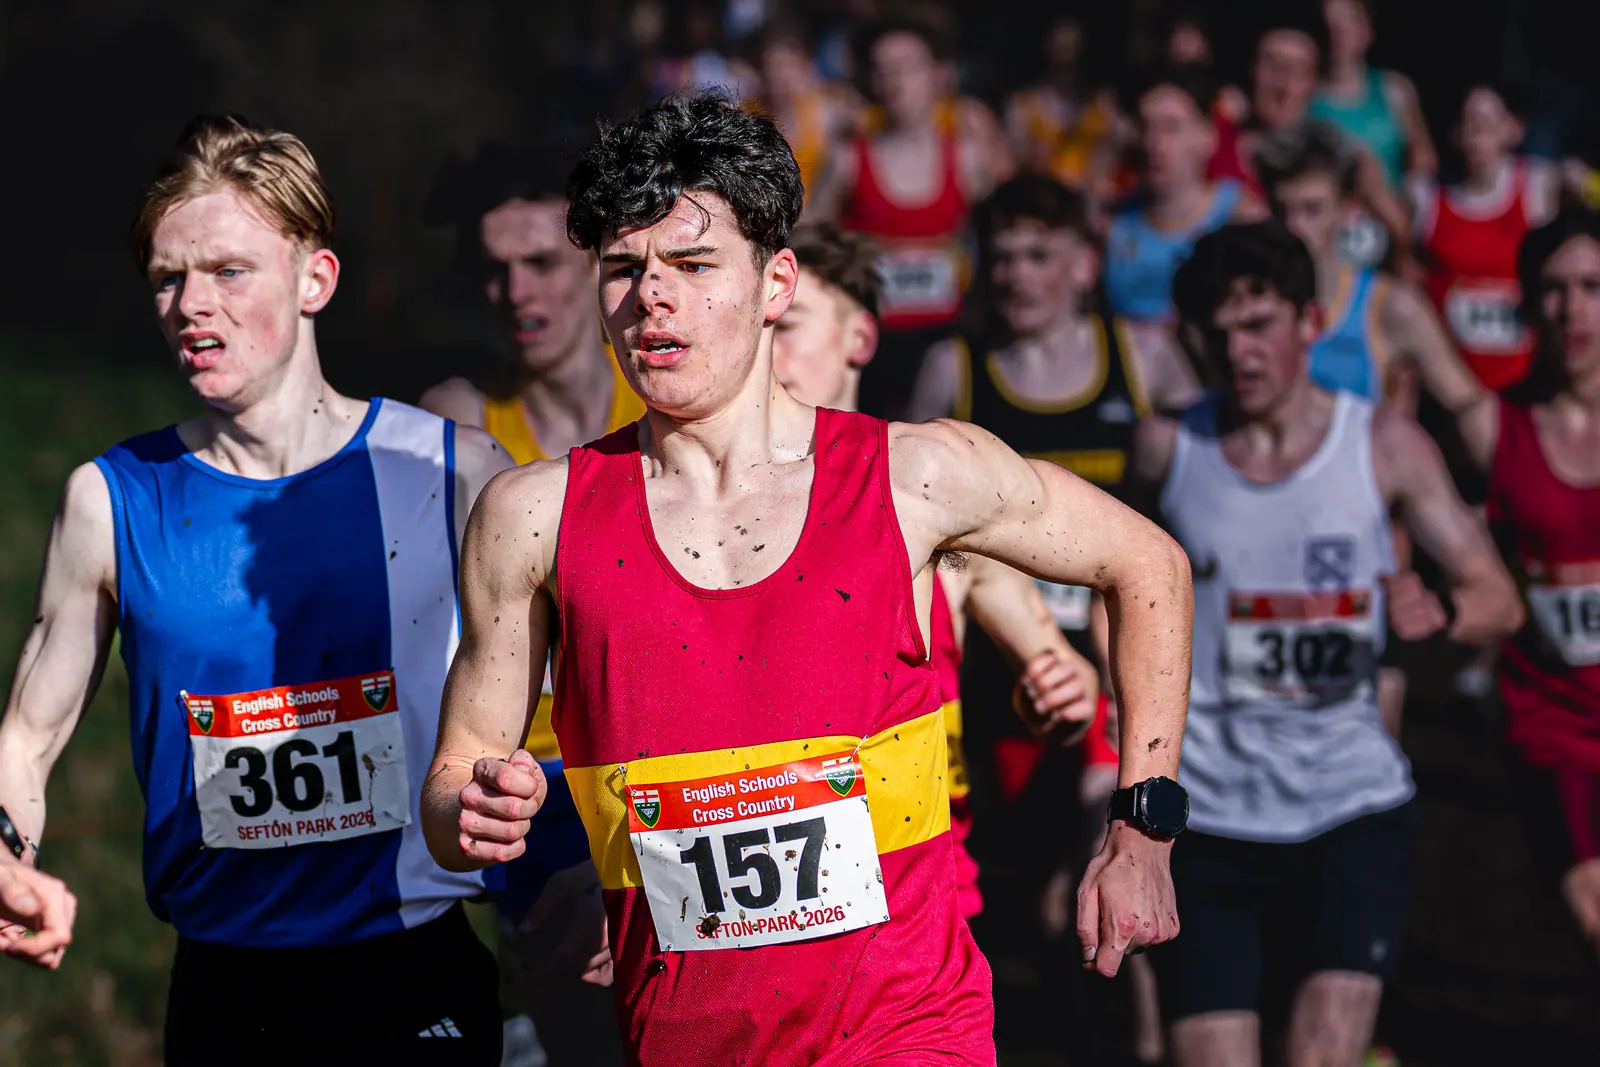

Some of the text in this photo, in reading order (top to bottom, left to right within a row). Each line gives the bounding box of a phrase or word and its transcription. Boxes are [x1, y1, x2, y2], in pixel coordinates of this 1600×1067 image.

[1253, 629, 1352, 677] 302
[233, 687, 340, 715] English Schools
[241, 708, 337, 734] Cross Country
[224, 730, 363, 818] 361
[682, 770, 798, 803] English Schools
[237, 810, 374, 840] SEFTON PARK 2026
[692, 795, 795, 823] Cross Country
[680, 816, 827, 914] 157
[695, 905, 845, 939] SFTON PARK 2026
